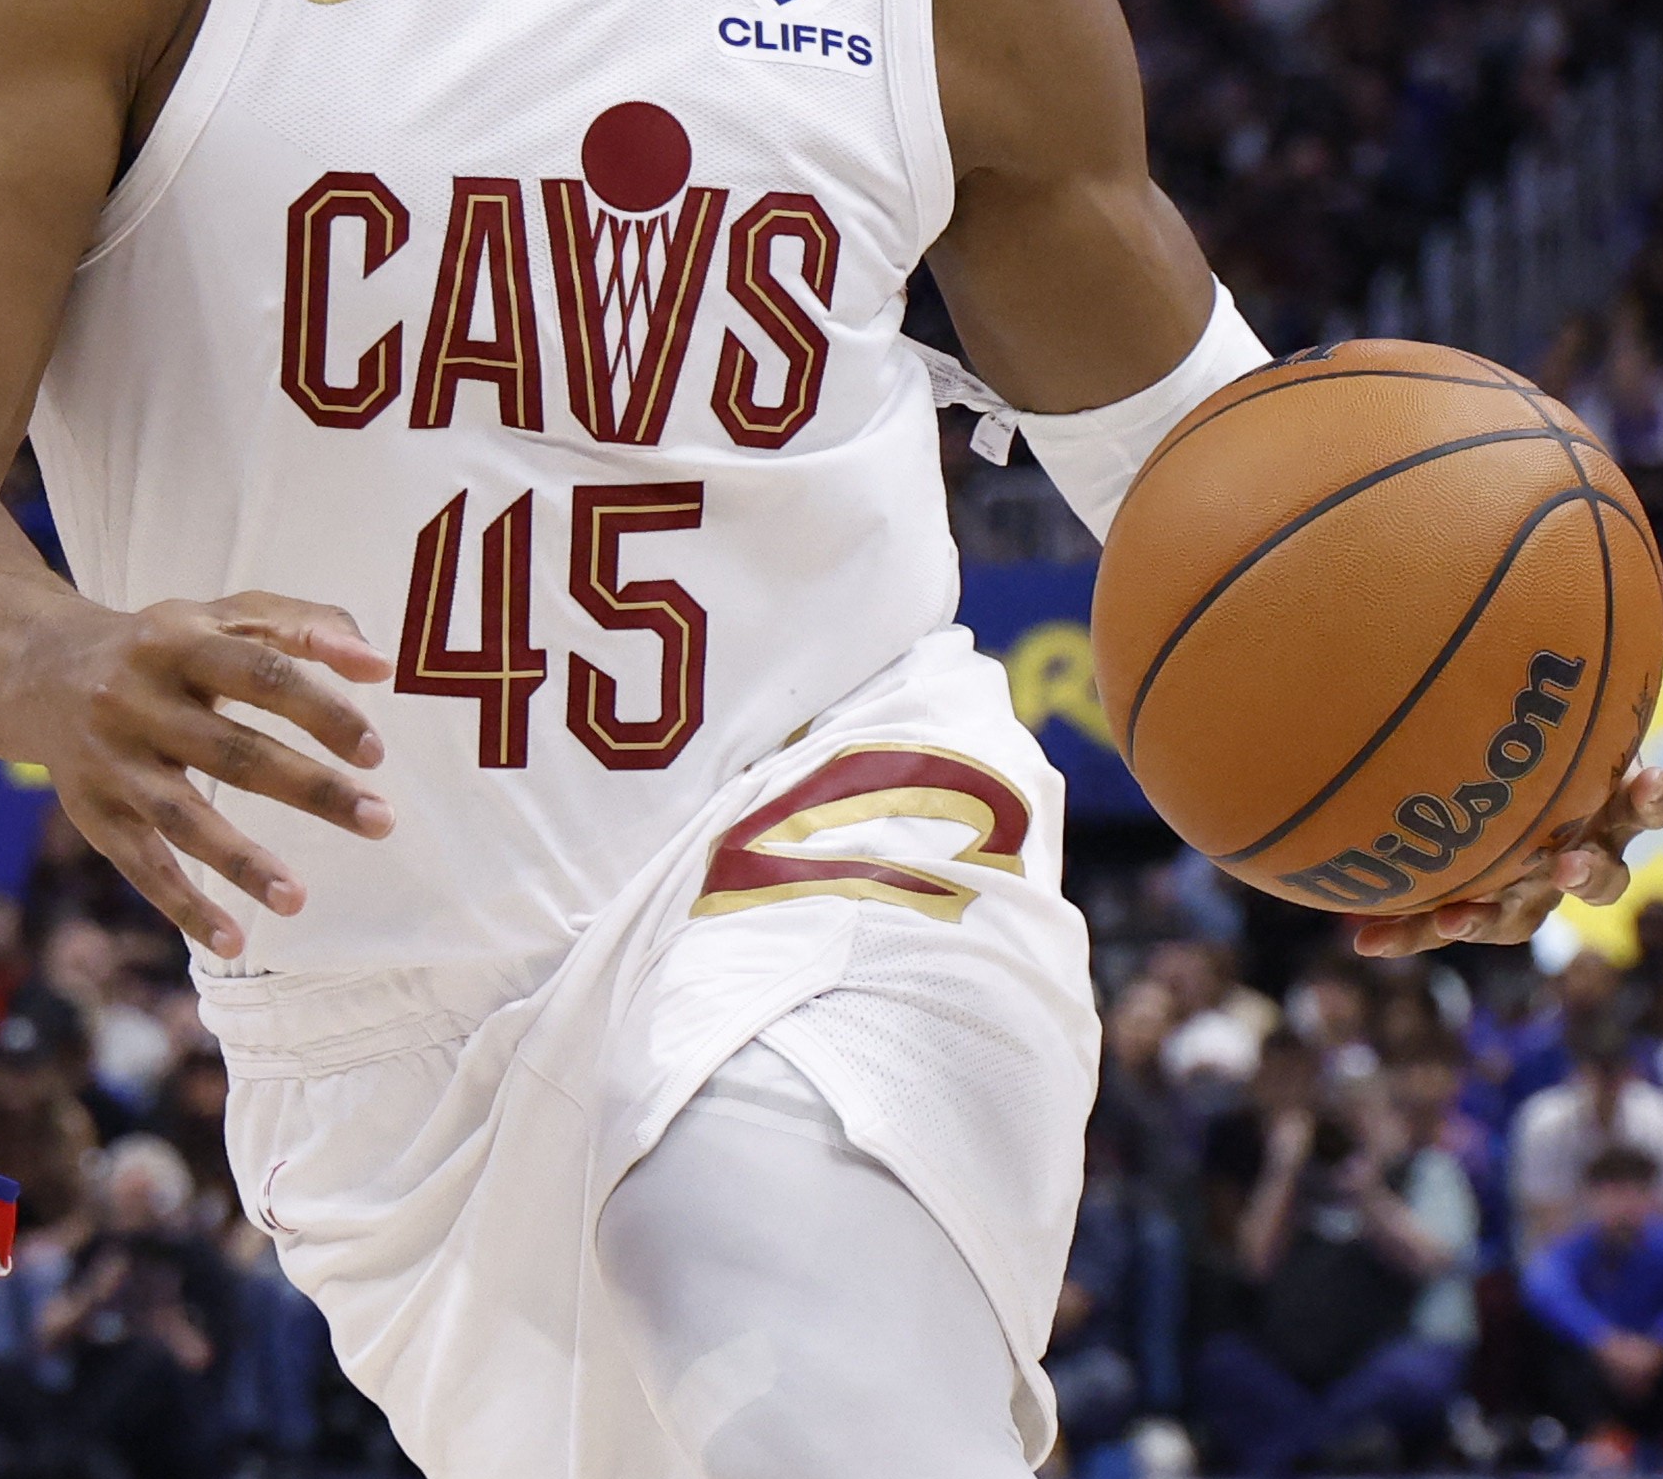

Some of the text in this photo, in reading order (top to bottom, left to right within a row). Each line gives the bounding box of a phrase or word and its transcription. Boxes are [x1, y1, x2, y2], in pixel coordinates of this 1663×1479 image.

[718, 17, 873, 66] CLIFFS
[281, 171, 841, 448] CAVS
[393, 480, 708, 772] 45
[1278, 649, 1586, 908] Wilson
